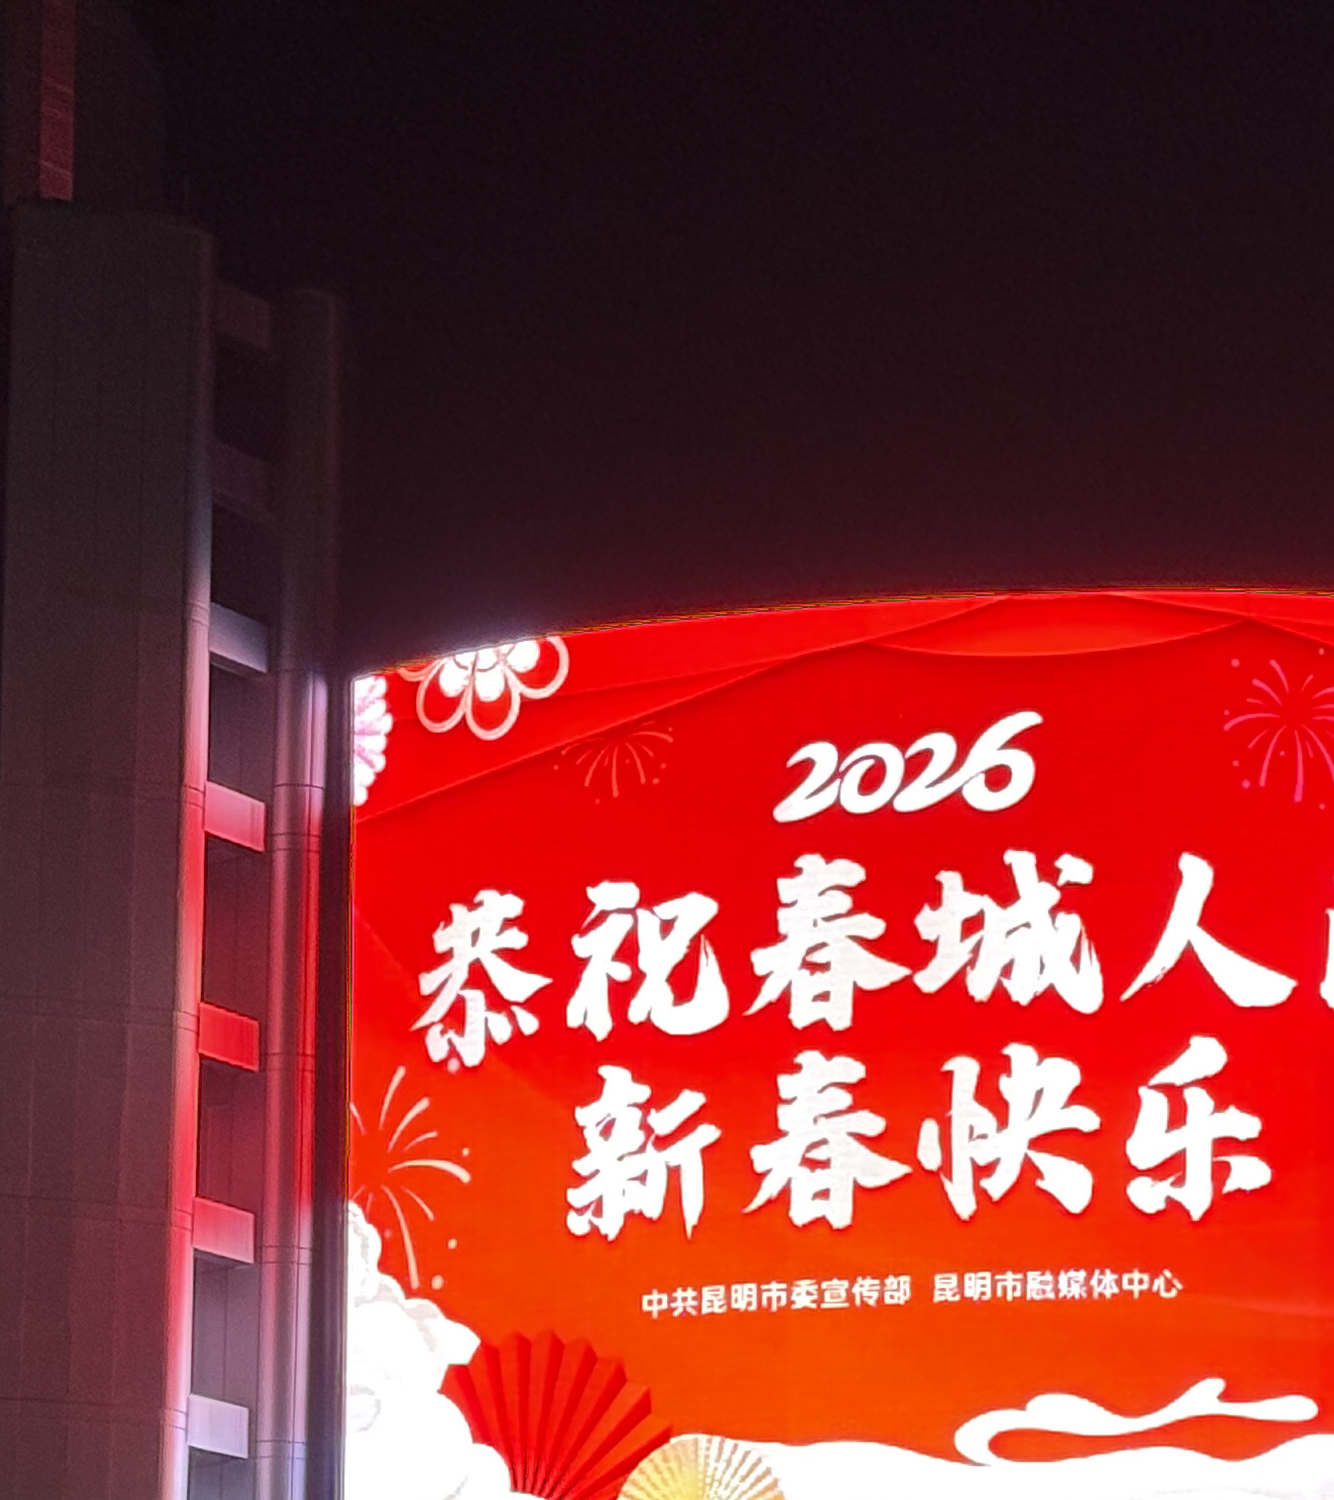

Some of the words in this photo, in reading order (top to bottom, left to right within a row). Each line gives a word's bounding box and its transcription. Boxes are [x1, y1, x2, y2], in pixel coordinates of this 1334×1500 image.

[773, 711, 1043, 822] 2026
[566, 1034, 1272, 1240] 新春快乐
[642, 1275, 911, 1318] 中共昆明市委宣传部
[933, 1268, 1183, 1303] 昆明市融媒体中心
